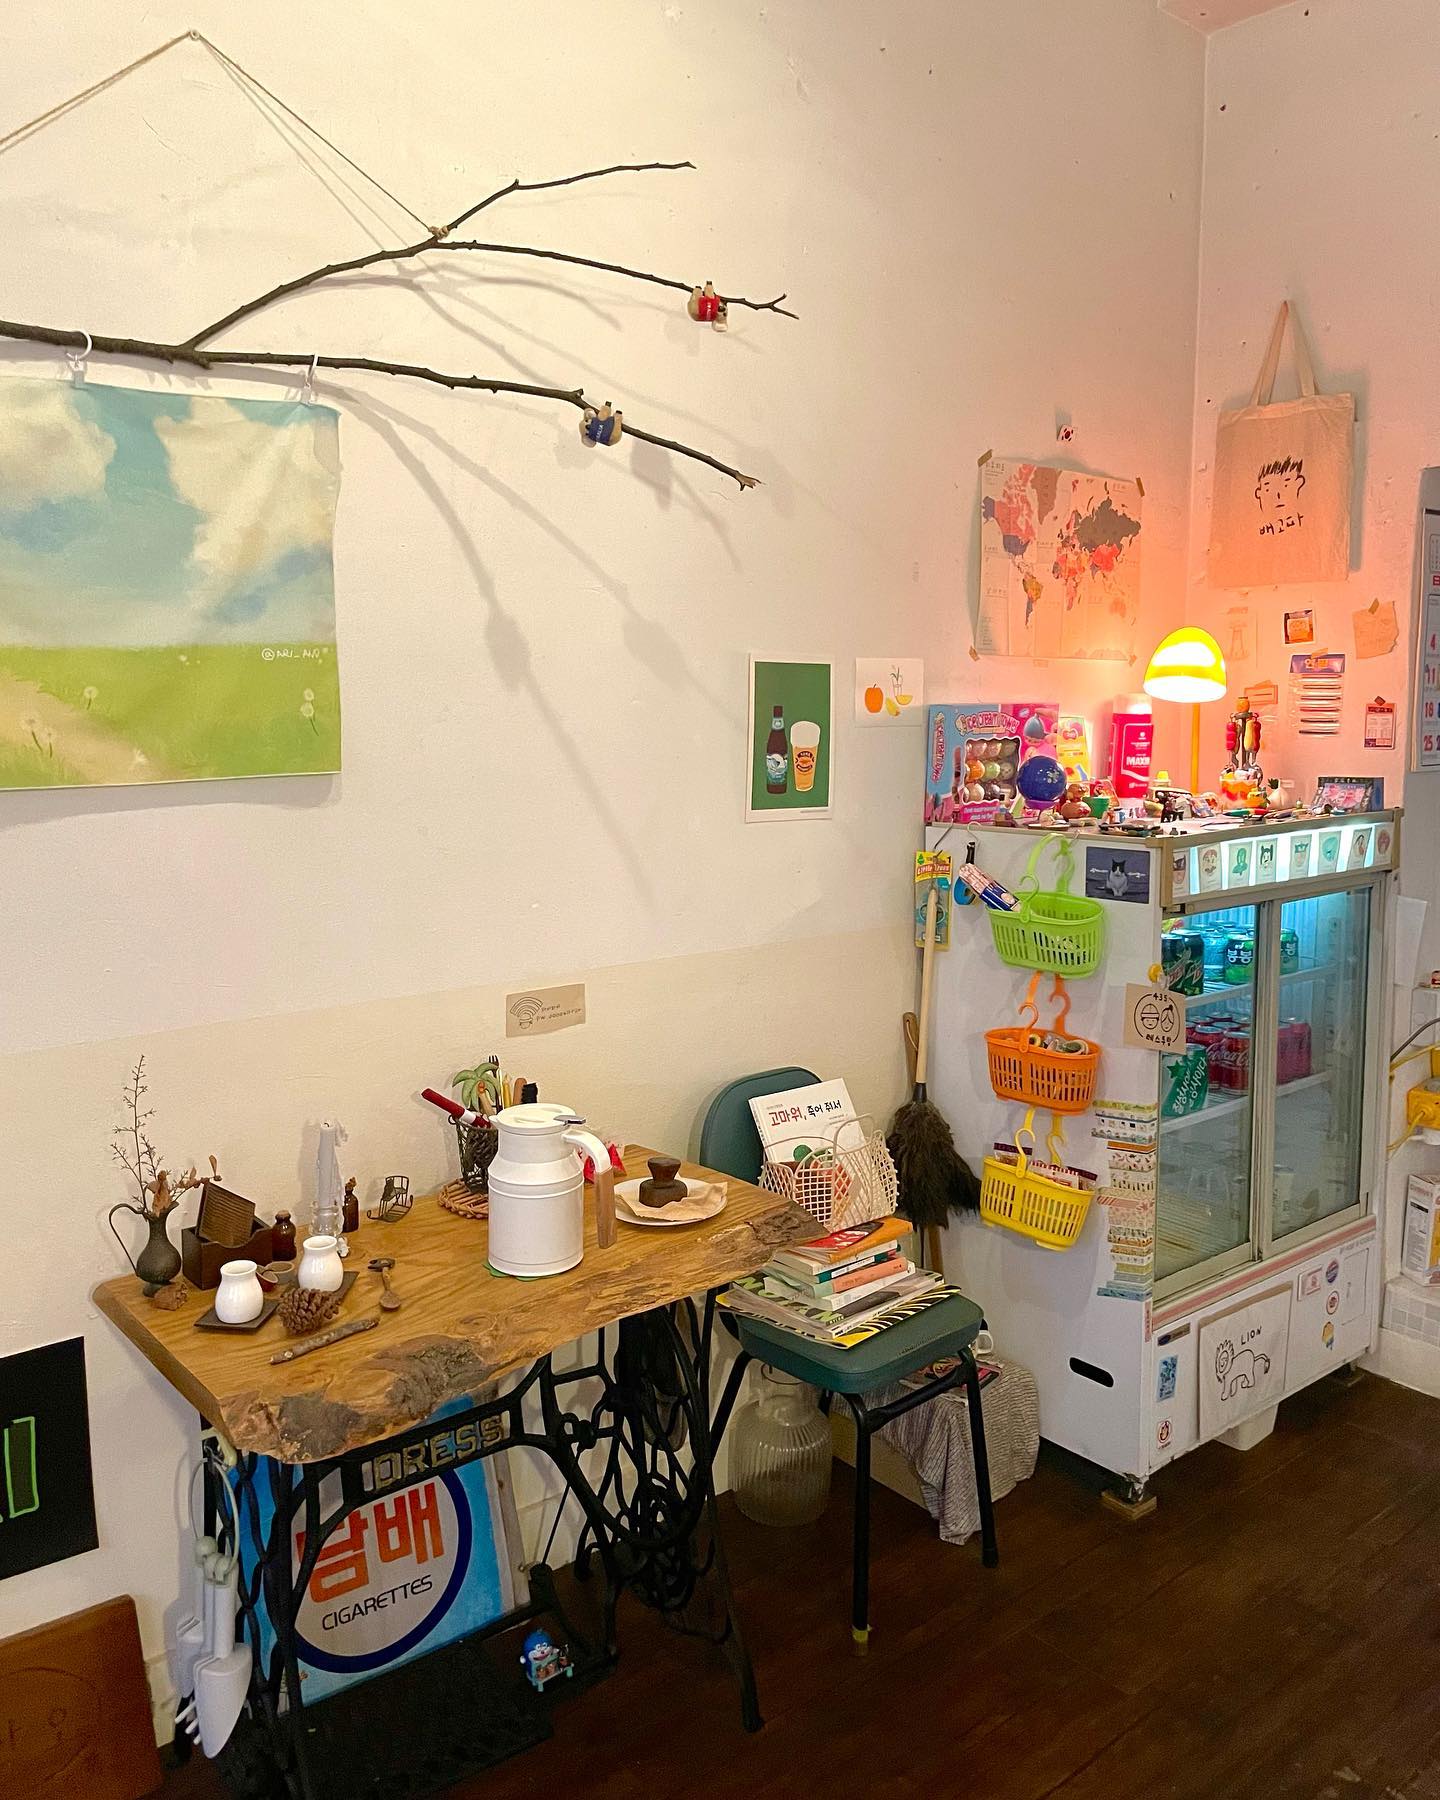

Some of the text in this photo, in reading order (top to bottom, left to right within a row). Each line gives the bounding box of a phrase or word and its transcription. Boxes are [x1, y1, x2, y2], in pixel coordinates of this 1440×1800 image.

[1259, 512, 1304, 535] 배고파
[1430, 633, 1436, 651] 4
[1425, 702, 1434, 718] 18
[1152, 992, 1168, 1002] 435
[768, 1106, 807, 1127] 고마워,
[807, 1104, 824, 1118] 죽어
[1240, 1325, 1262, 1346] LION
[321, 1574, 433, 1631] CIGARETTES
